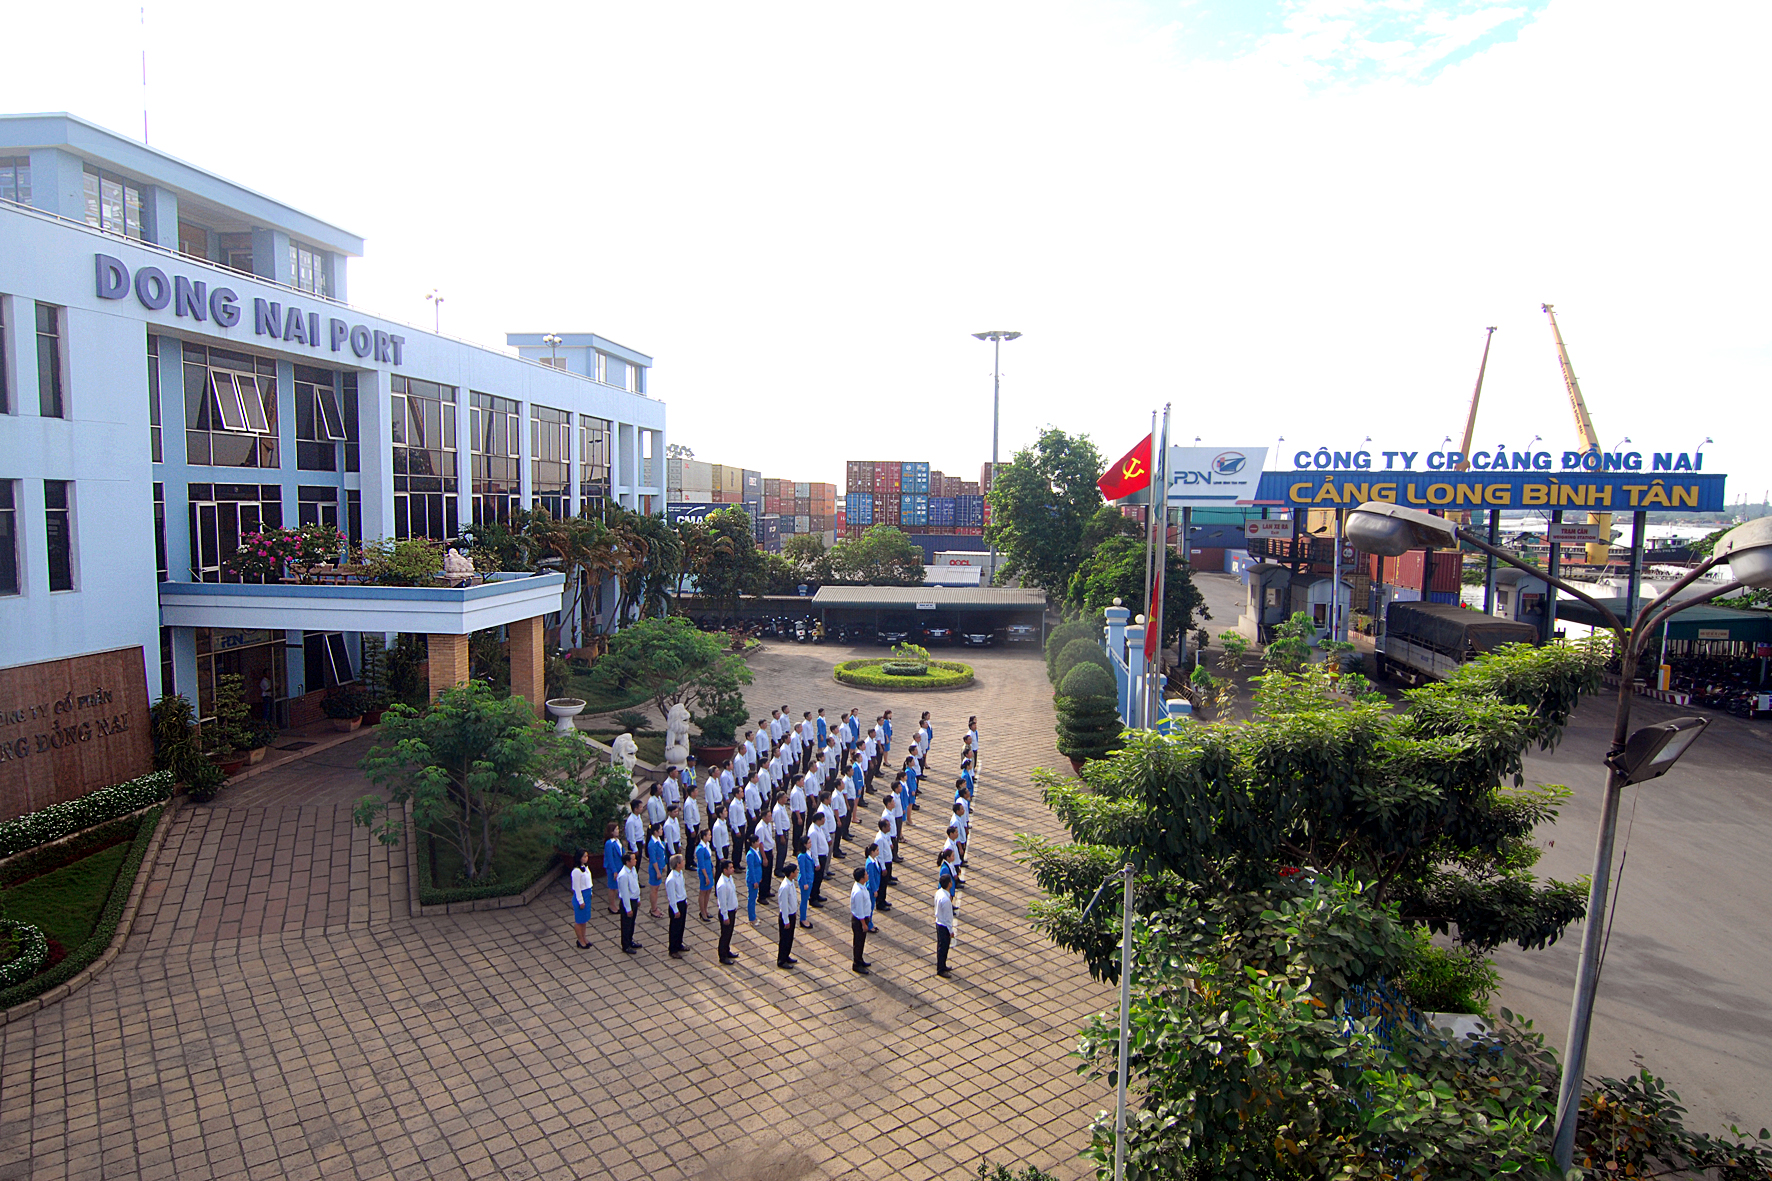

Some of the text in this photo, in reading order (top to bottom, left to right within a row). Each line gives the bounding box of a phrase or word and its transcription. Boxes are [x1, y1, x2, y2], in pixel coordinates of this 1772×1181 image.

[94, 253, 406, 366] DONG NAI PORT
[1294, 443, 1703, 471] CÔNG TY CP CẢNG ĐỒNG NAI
[1174, 471, 1212, 485] PDN
[1289, 475, 1699, 507] CẢNG LONG BÌNH TÂN
[96, 713, 129, 738] NAI
